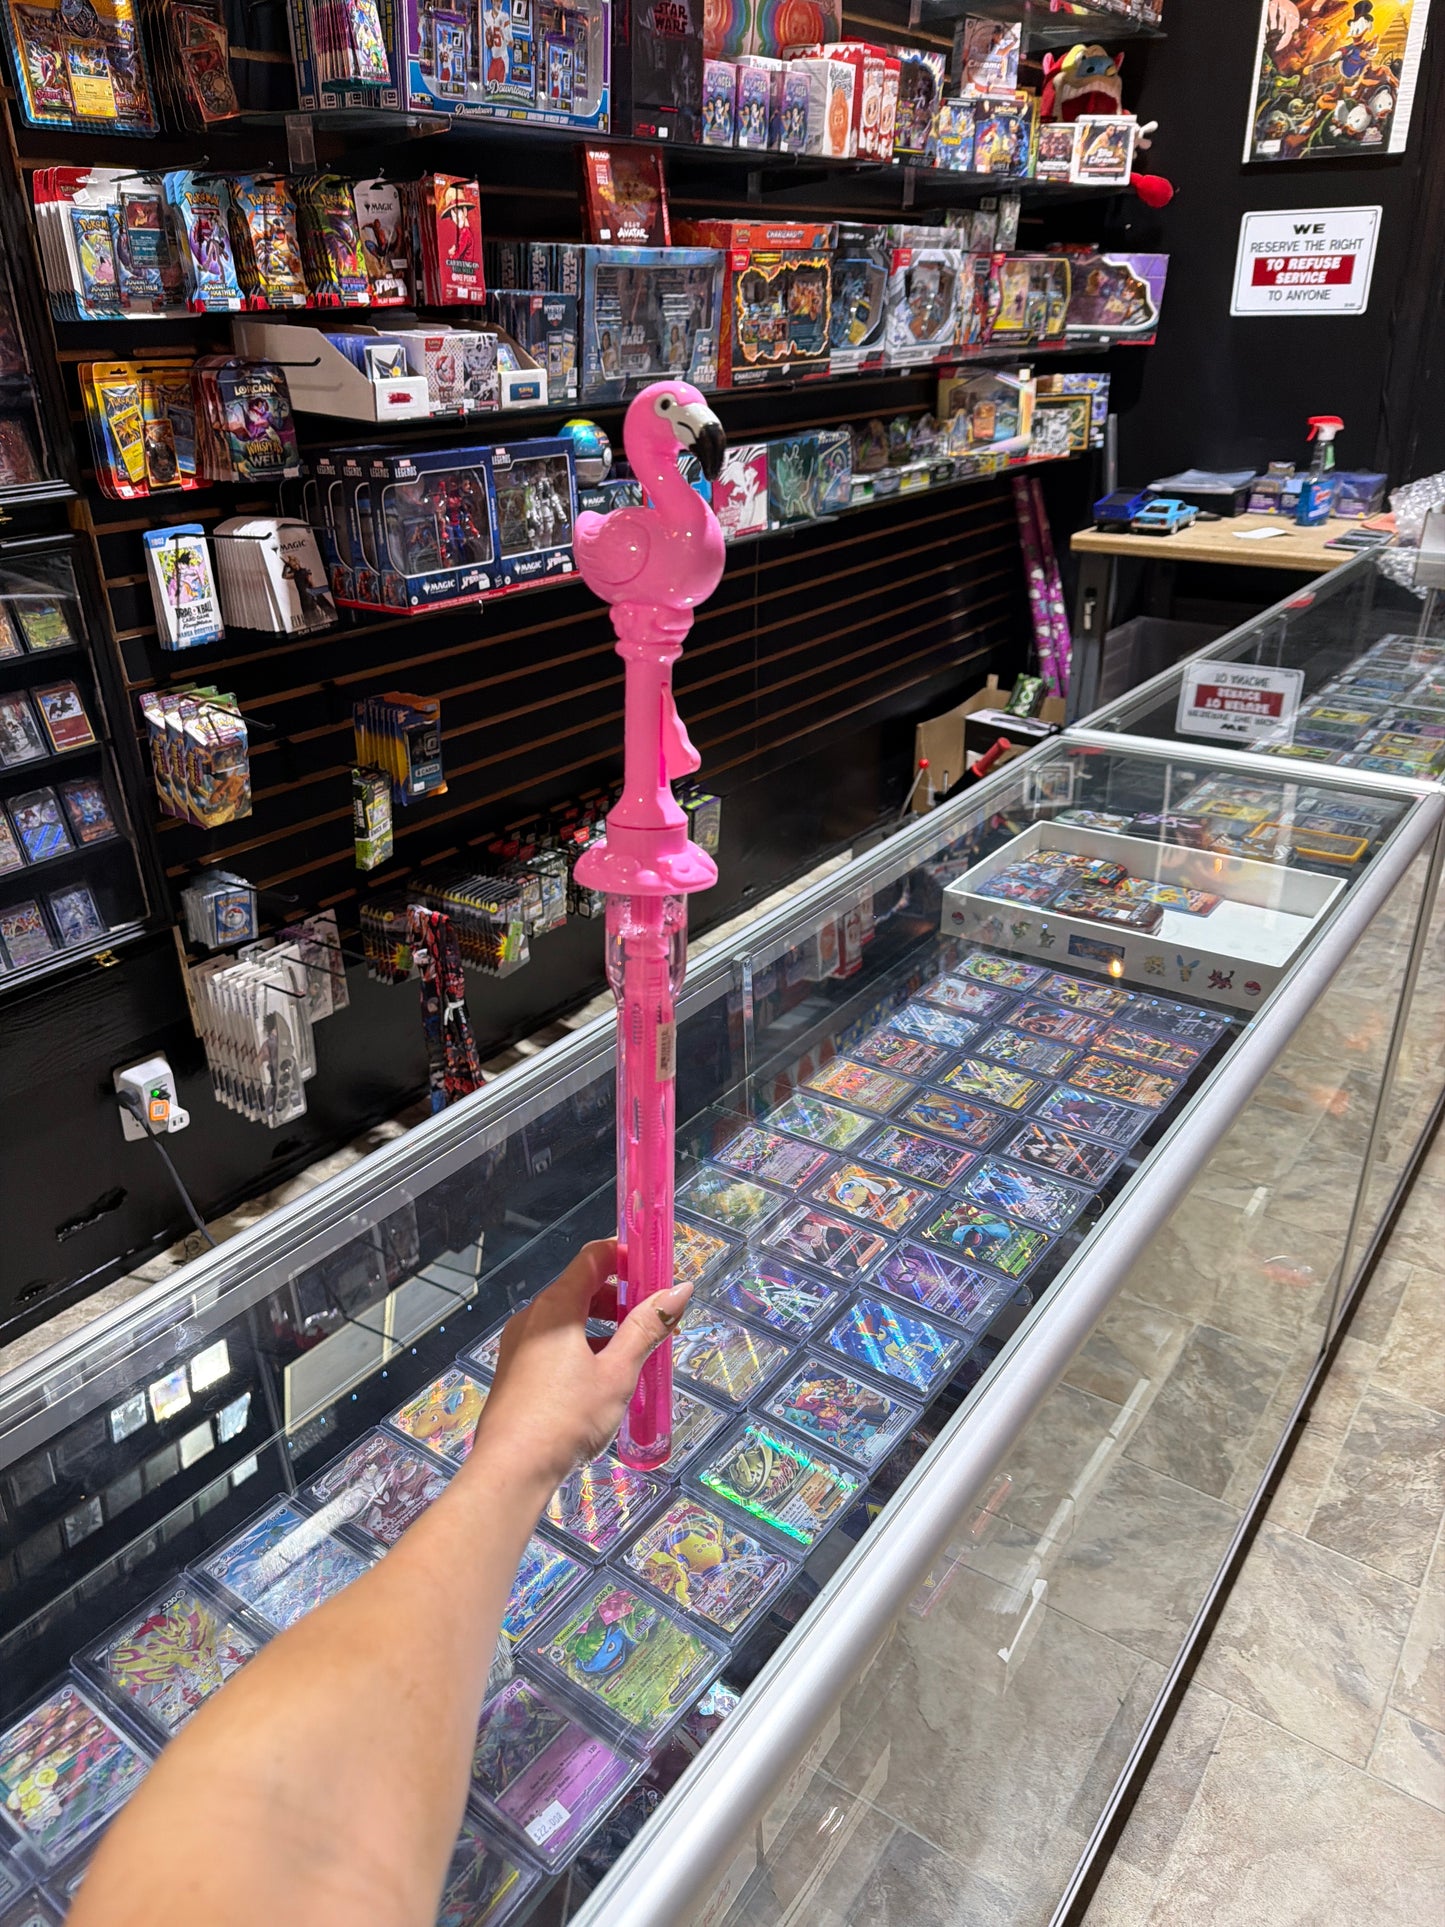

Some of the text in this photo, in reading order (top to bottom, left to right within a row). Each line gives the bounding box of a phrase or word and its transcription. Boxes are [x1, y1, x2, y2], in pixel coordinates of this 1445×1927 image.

[654, 1, 688, 20] STAR
[654, 15, 688, 34] WARS
[486, 79, 530, 99] Downtown
[455, 103, 493, 116] Downtown
[371, 202, 393, 211] MAGIC
[1293, 223, 1326, 235] WE
[1250, 238, 1364, 253] RESERVE THE RIGHT
[1266, 256, 1342, 271] TO REFUSE
[1275, 271, 1328, 284] SERVICE
[1268, 289, 1331, 301] TO ANYONE
[234, 385, 278, 397] LORCANA
[252, 455, 285, 467] WELL
[492, 454, 511, 464] LEGENDS
[394, 465, 417, 478] LEGENDS
[280, 540, 306, 550] MAGIC
[520, 560, 542, 572] MAGIC
[430, 578, 456, 592] MAGIC
[504, 1686, 518, 1700] 120
